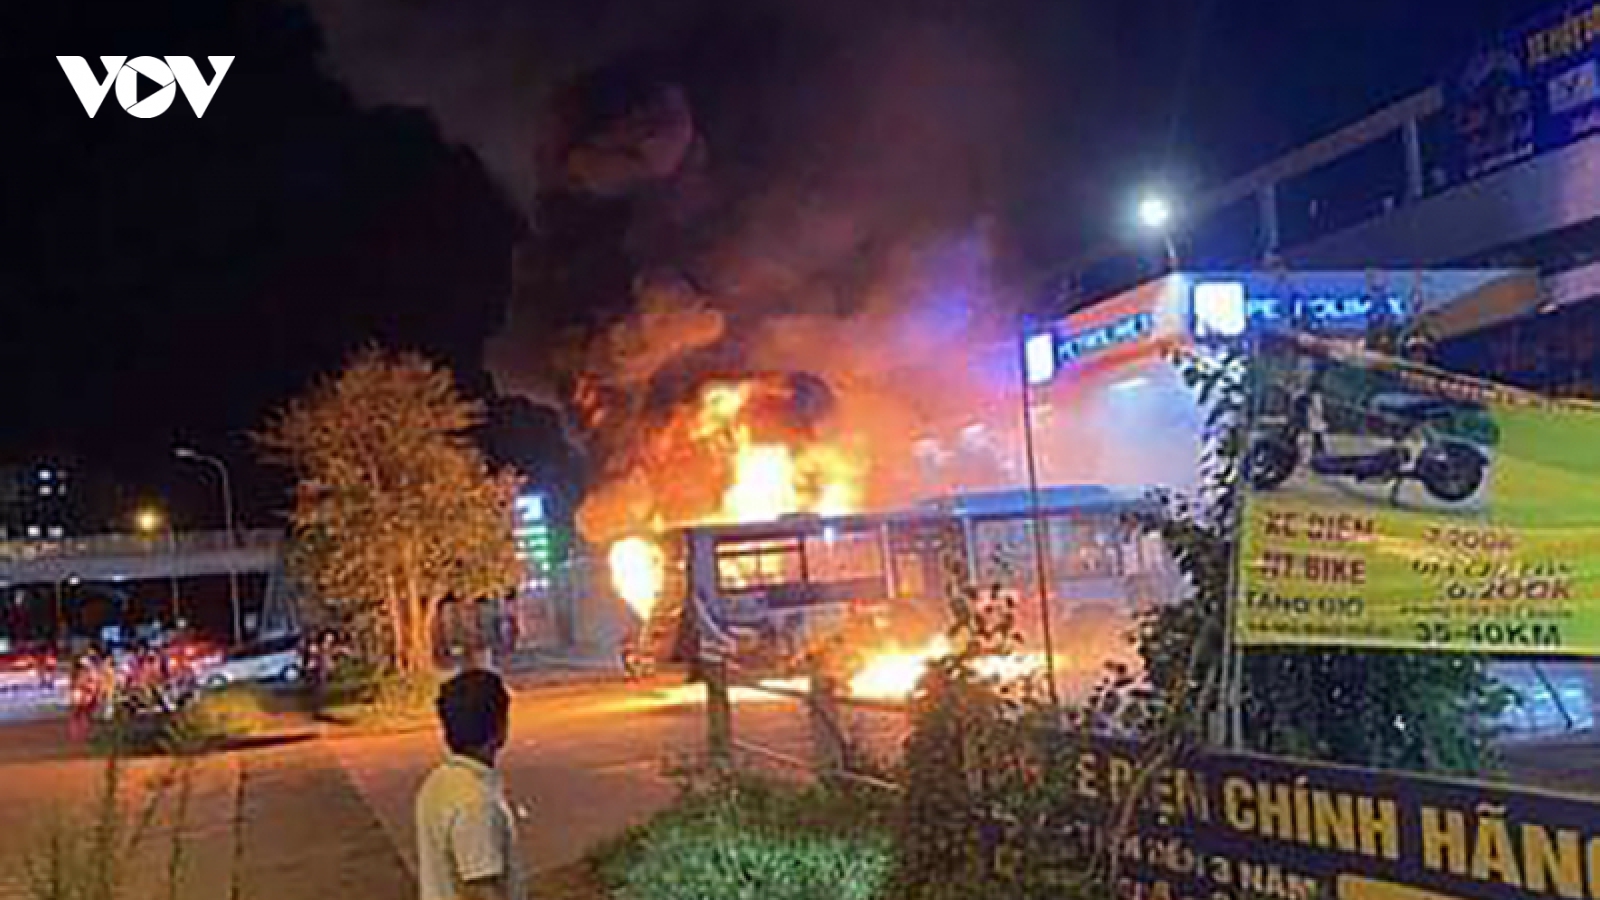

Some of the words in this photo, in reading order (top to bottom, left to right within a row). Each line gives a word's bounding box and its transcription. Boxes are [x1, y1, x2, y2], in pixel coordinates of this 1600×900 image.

[1305, 555, 1367, 584] BIKE
[1223, 775, 1399, 861] CHÍNH
[1422, 801, 1600, 900] HÃN
